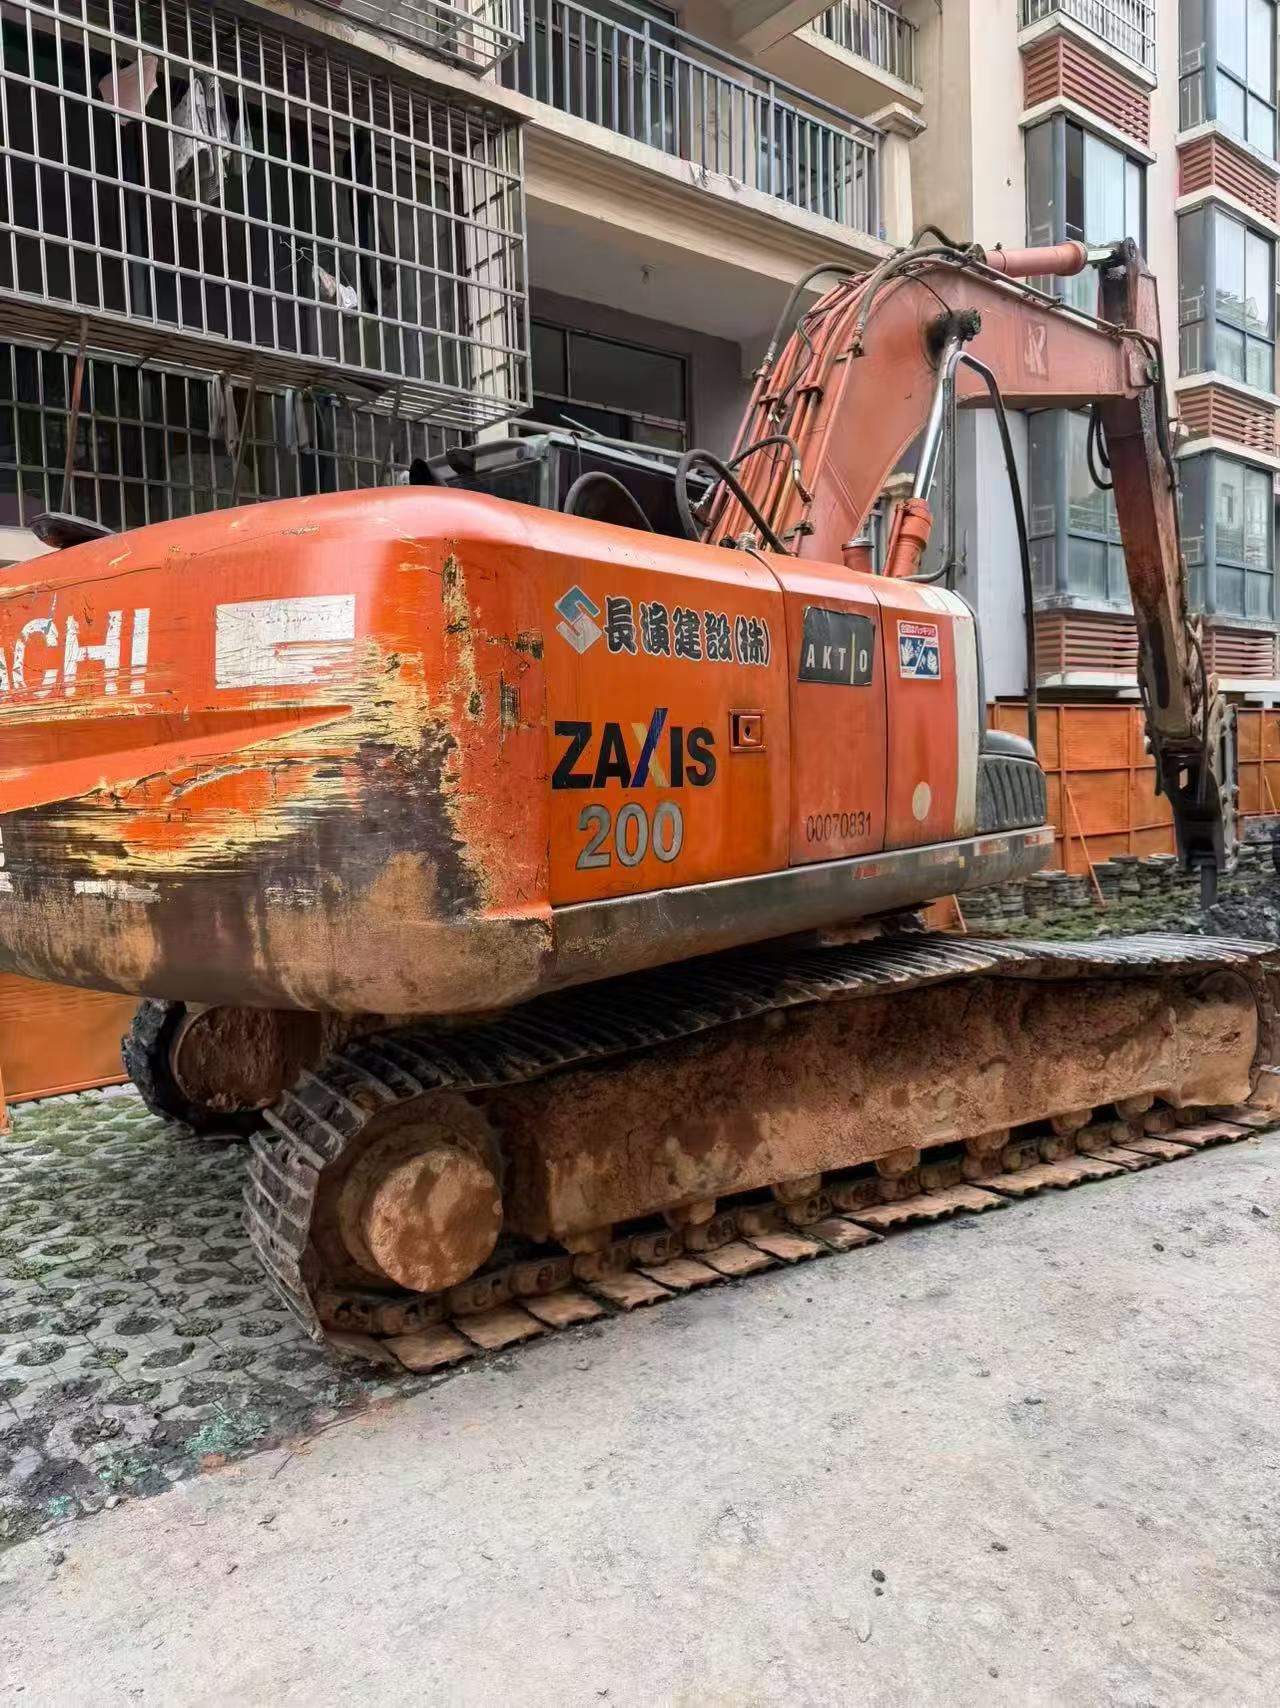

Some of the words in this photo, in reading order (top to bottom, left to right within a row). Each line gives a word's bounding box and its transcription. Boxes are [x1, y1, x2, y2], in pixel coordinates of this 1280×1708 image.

[0, 607, 150, 697] CHI
[805, 632, 868, 685] AKTIO
[551, 708, 717, 789] ZAXIS
[575, 800, 684, 871] 200
[806, 810, 871, 842] 00070831
